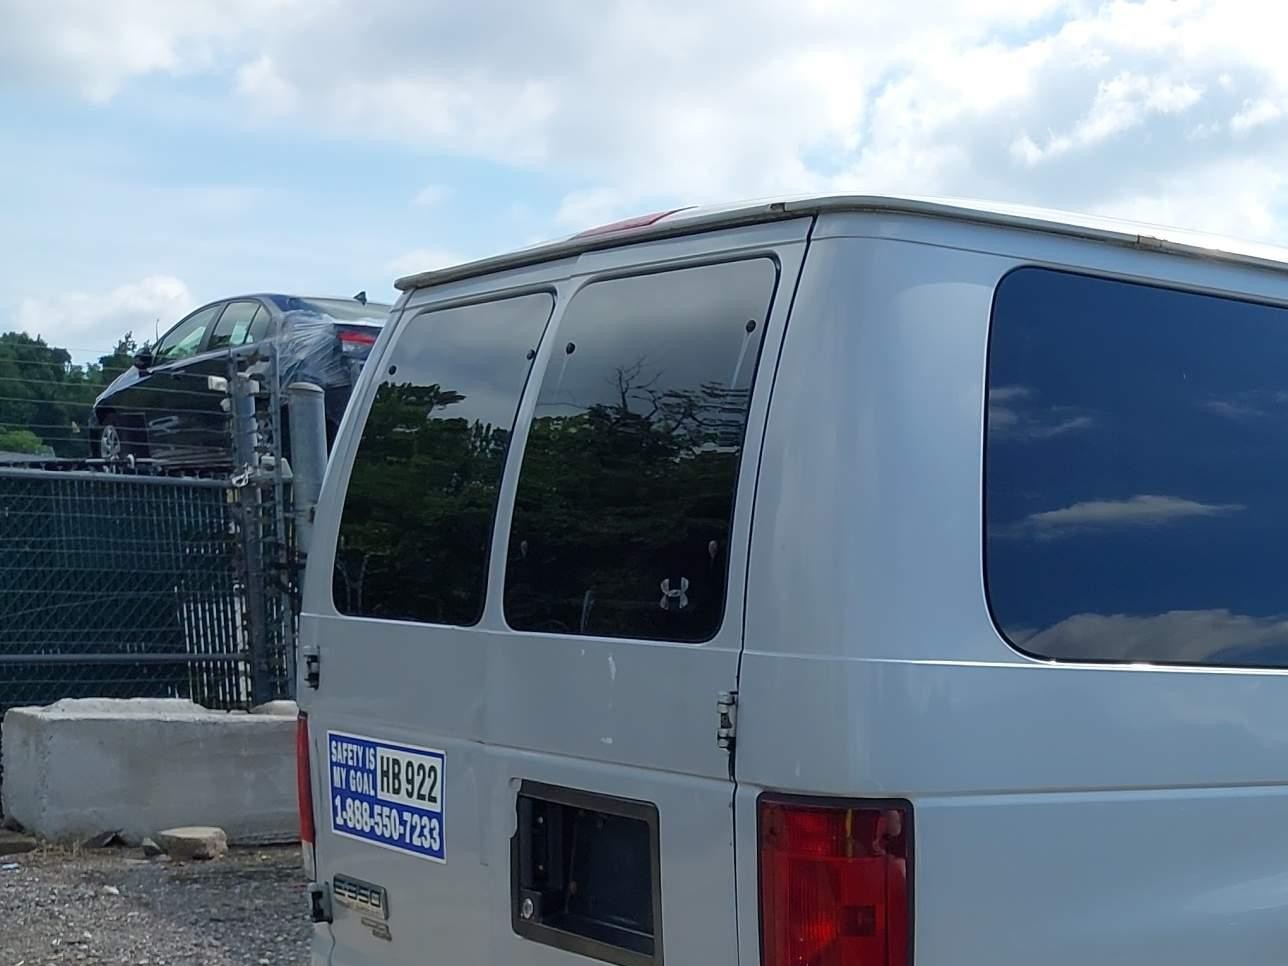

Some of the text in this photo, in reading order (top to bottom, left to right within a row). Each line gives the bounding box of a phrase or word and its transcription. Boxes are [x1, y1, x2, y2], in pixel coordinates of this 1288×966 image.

[331, 740, 376, 770] SAFETY IS
[333, 765, 376, 796] MY GOAL
[380, 755, 438, 804] HB 922
[335, 795, 441, 851] 1-888-550-7233
